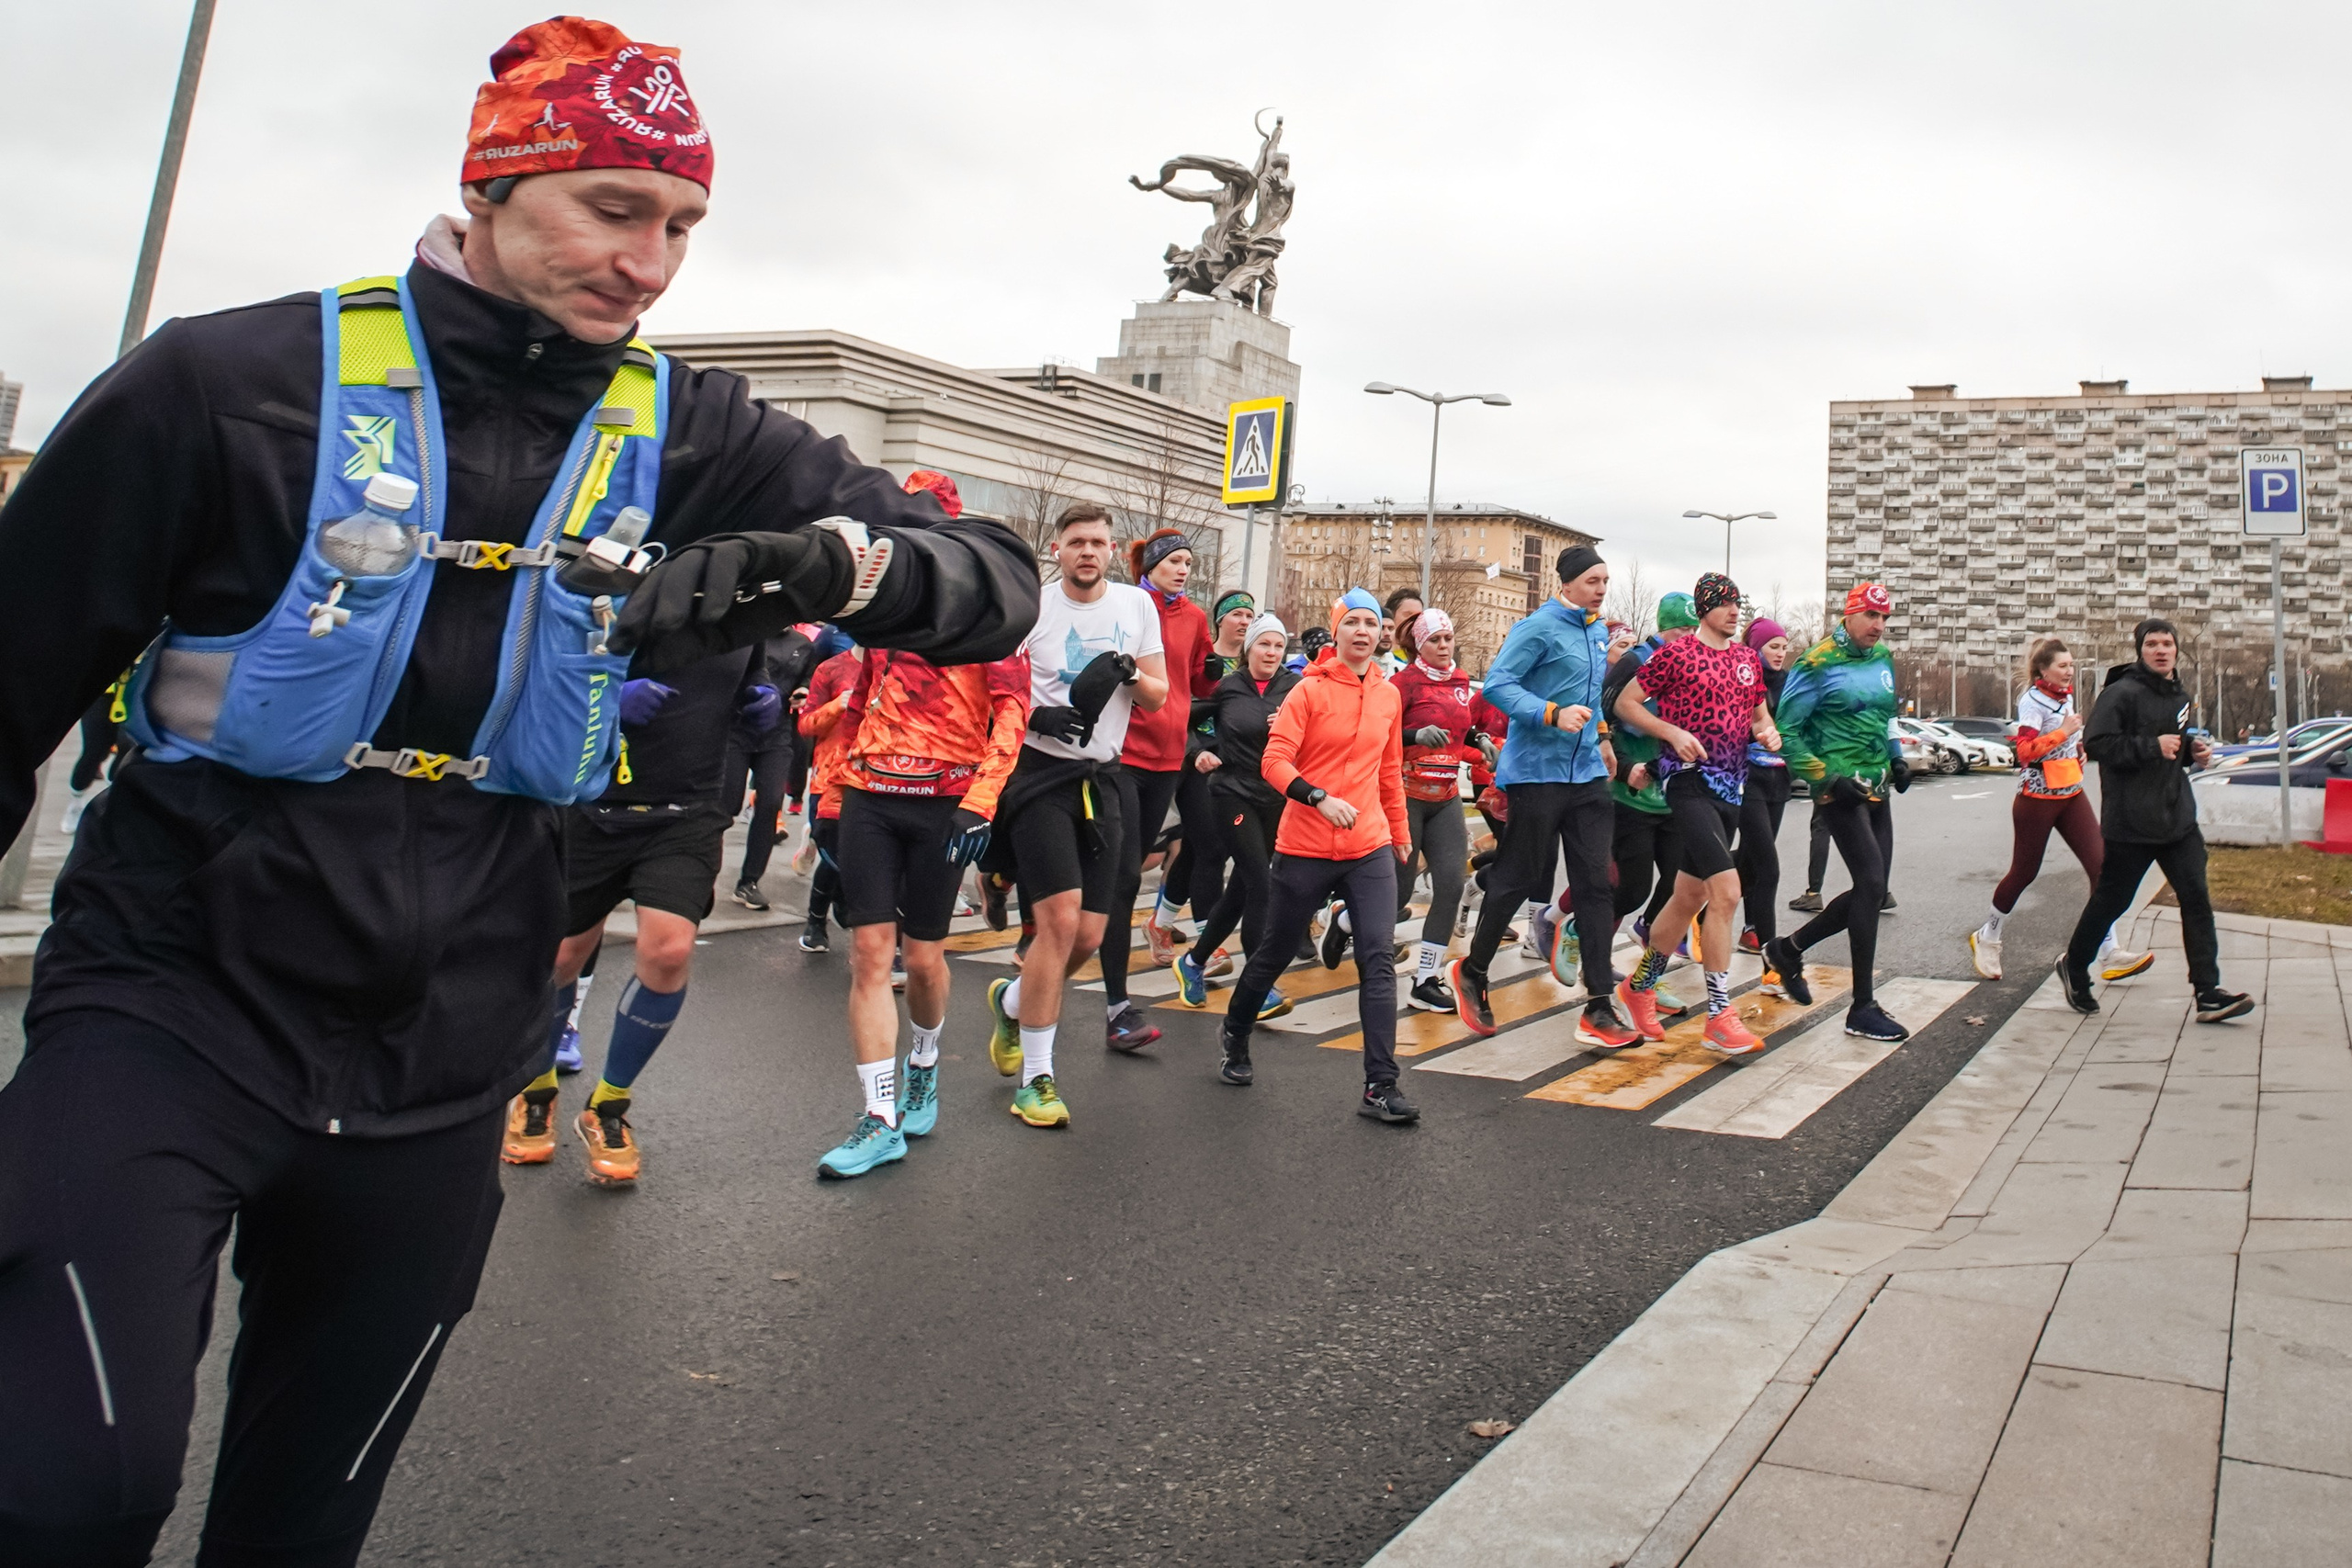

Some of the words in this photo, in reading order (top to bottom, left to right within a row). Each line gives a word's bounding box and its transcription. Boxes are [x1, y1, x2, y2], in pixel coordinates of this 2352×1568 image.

[2255, 454, 2289, 463] ЗОНА
[2262, 472, 2289, 509] P
[572, 671, 608, 784] Tanluhu
